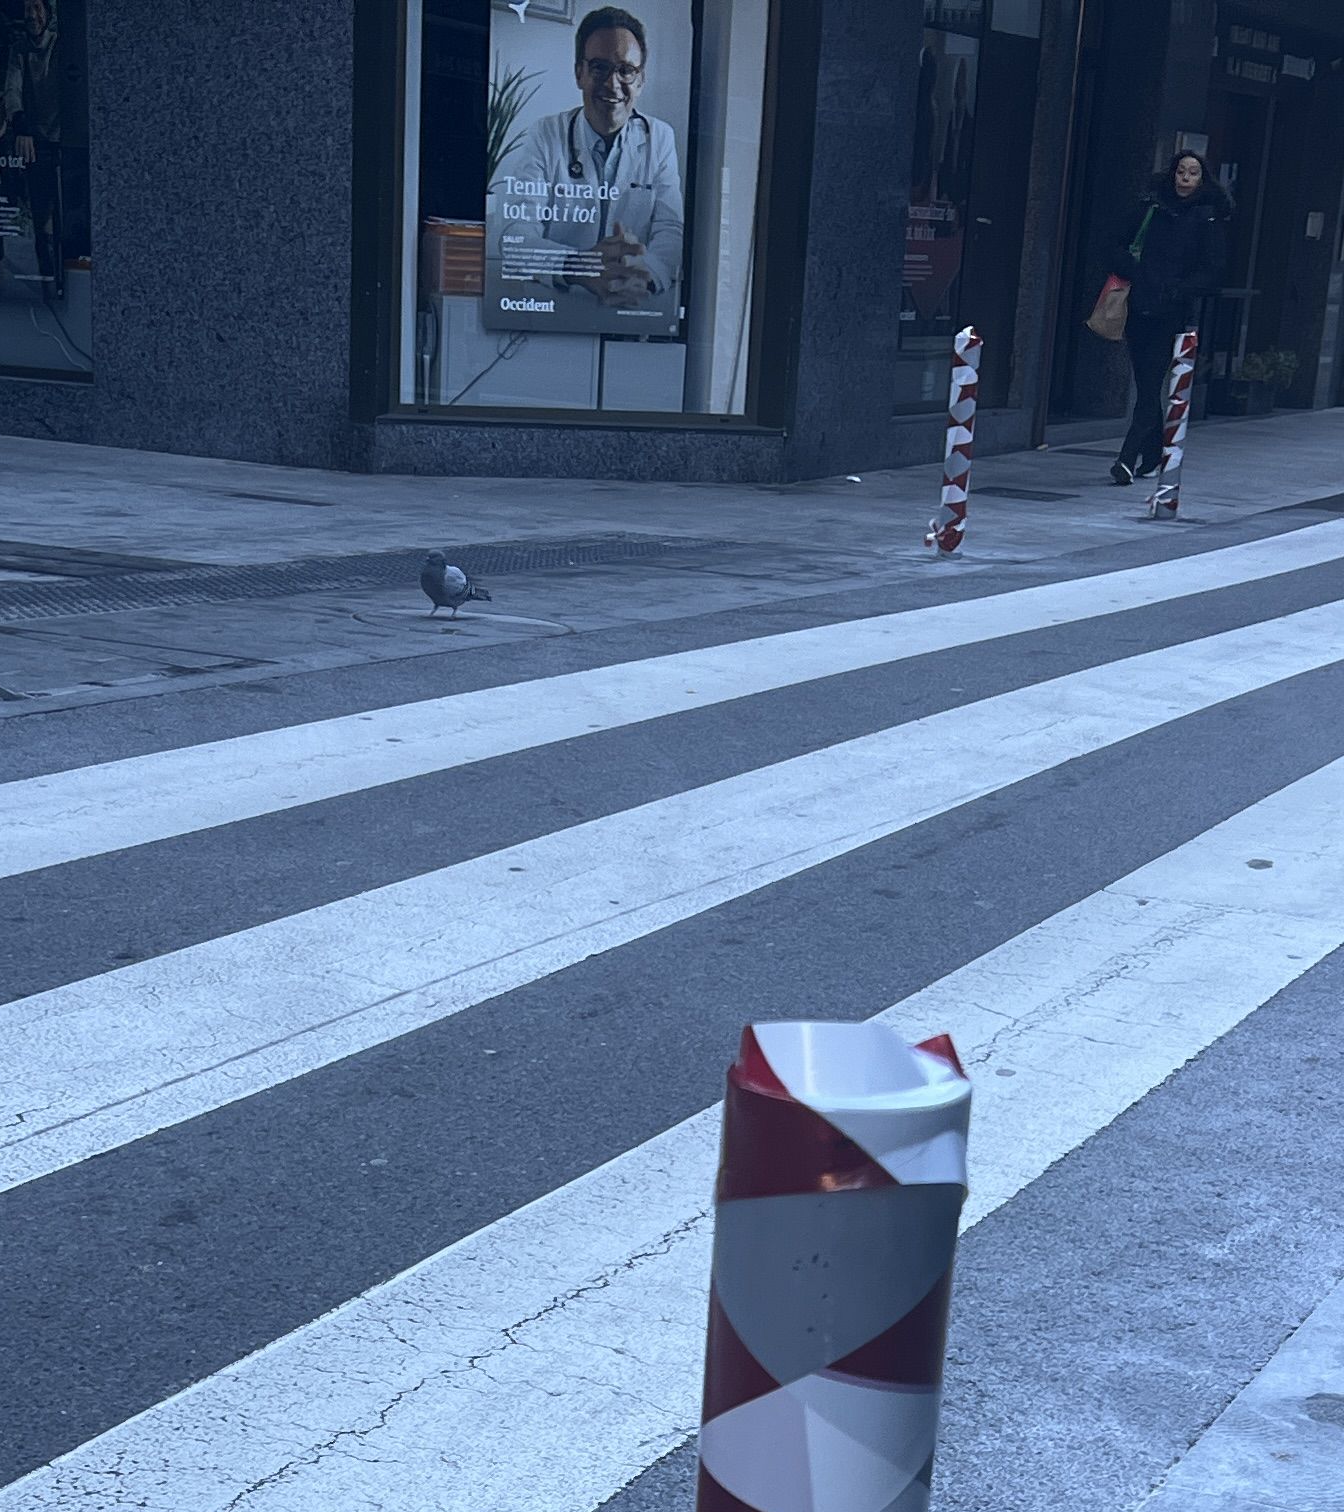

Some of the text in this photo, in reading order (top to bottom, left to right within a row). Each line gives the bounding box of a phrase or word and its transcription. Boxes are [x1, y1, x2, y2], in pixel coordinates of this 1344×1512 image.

[503, 176, 620, 200] Tenir cura de
[503, 202, 531, 221] tot,
[536, 203, 559, 222] tot
[572, 205, 598, 223] tot
[500, 297, 555, 313] Occident
